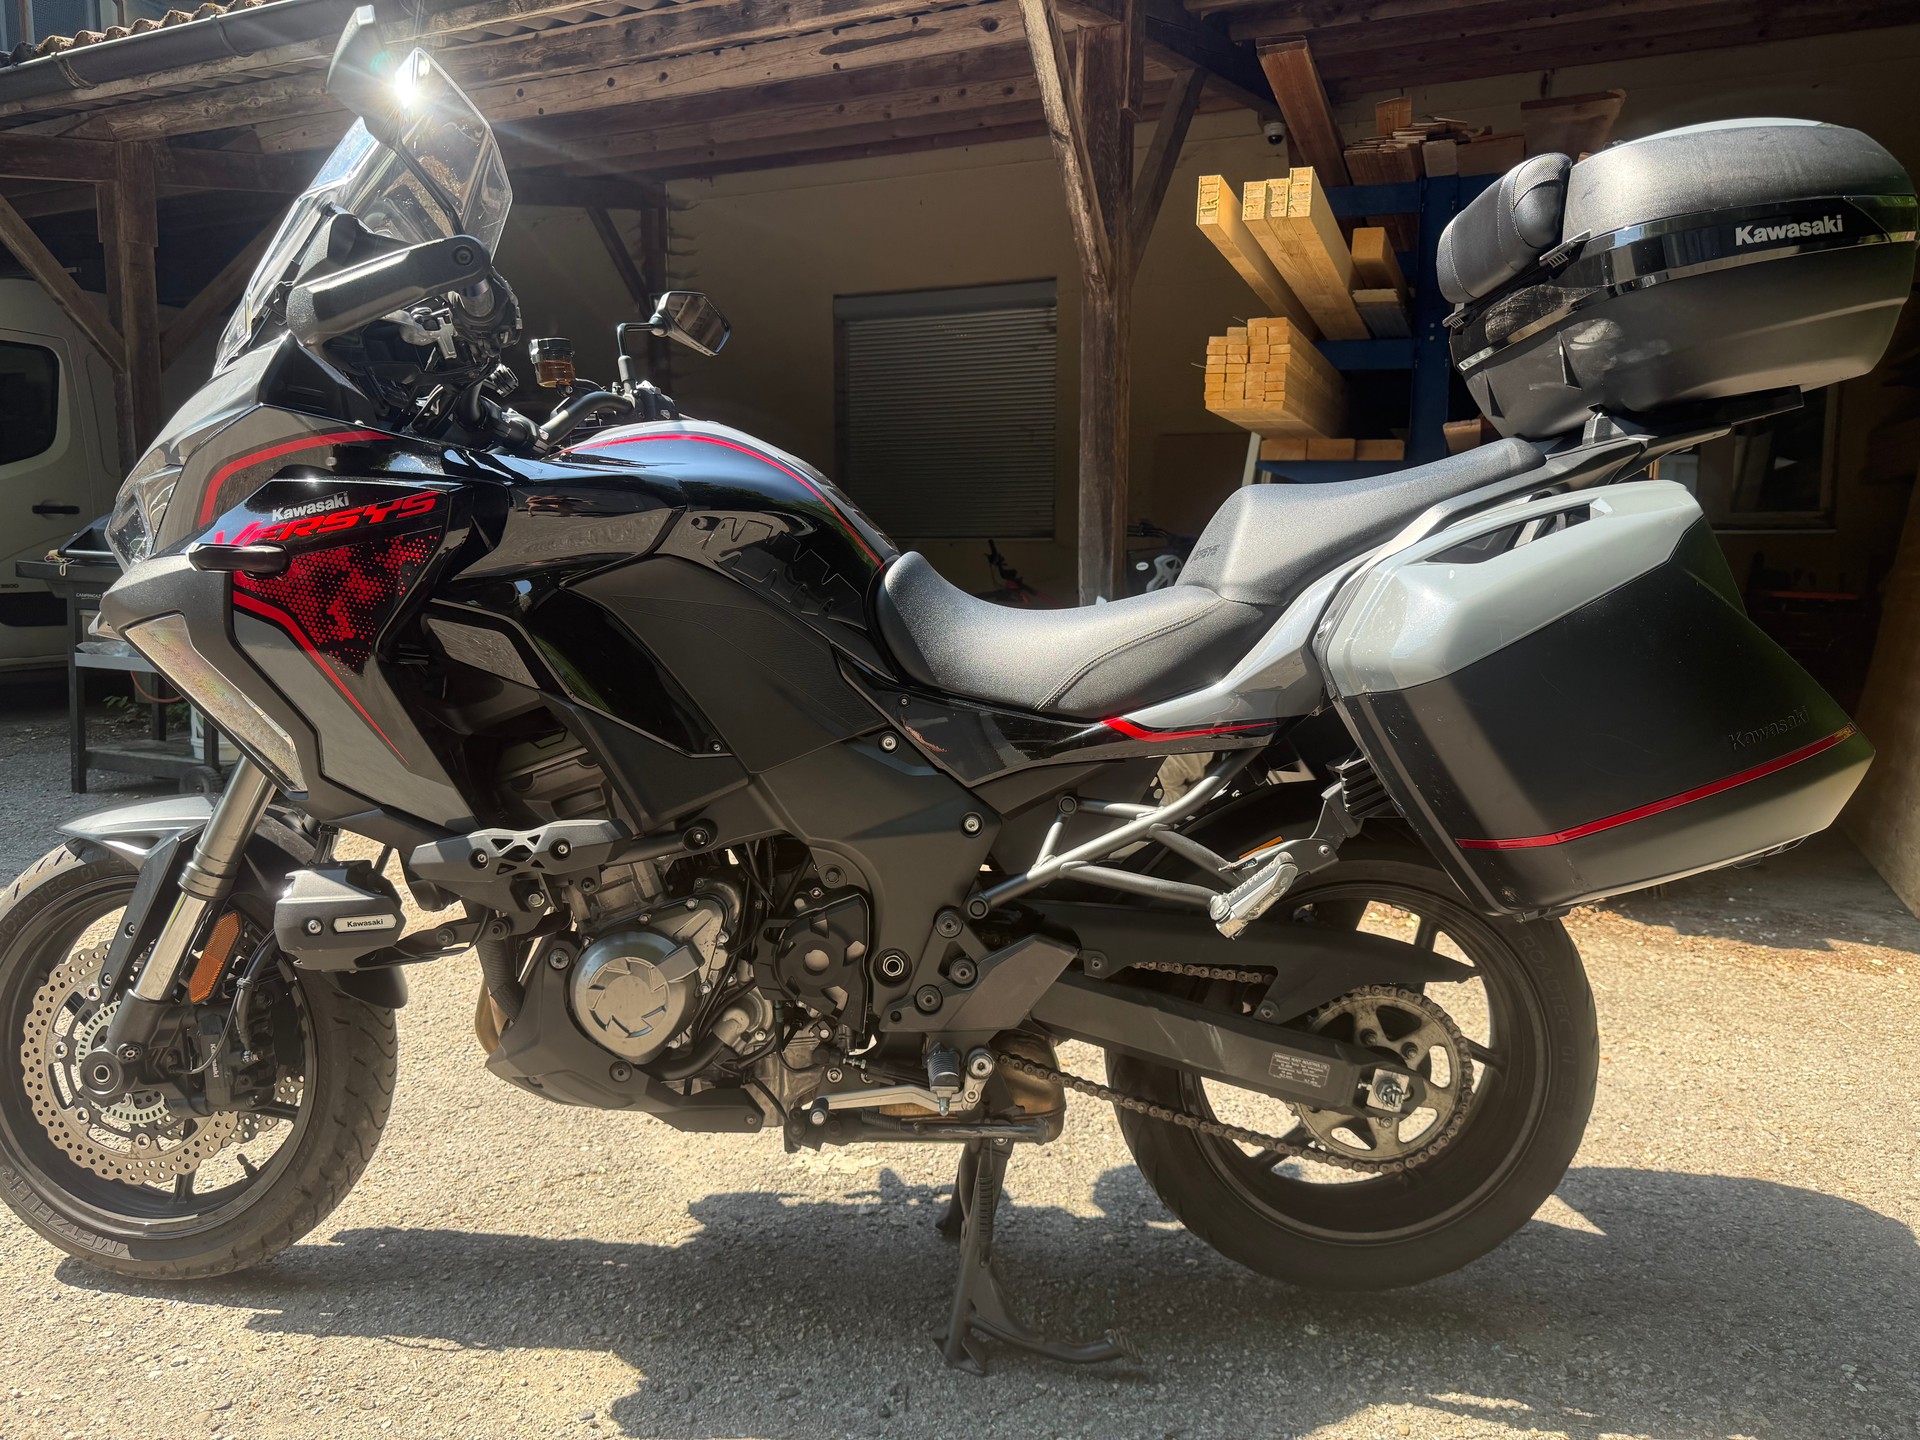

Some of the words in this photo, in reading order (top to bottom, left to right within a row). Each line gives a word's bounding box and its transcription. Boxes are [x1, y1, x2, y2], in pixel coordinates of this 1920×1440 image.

[1735, 214, 1844, 246] Kawasaki
[271, 491, 350, 523] Kawasaki
[1728, 705, 1810, 750] Kawasaki
[0, 876, 71, 946] OADTEC
[347, 919, 384, 927] Kawasaki
[1517, 934, 1574, 1033] ROADTEC
[1, 1164, 118, 1255] METZELER
